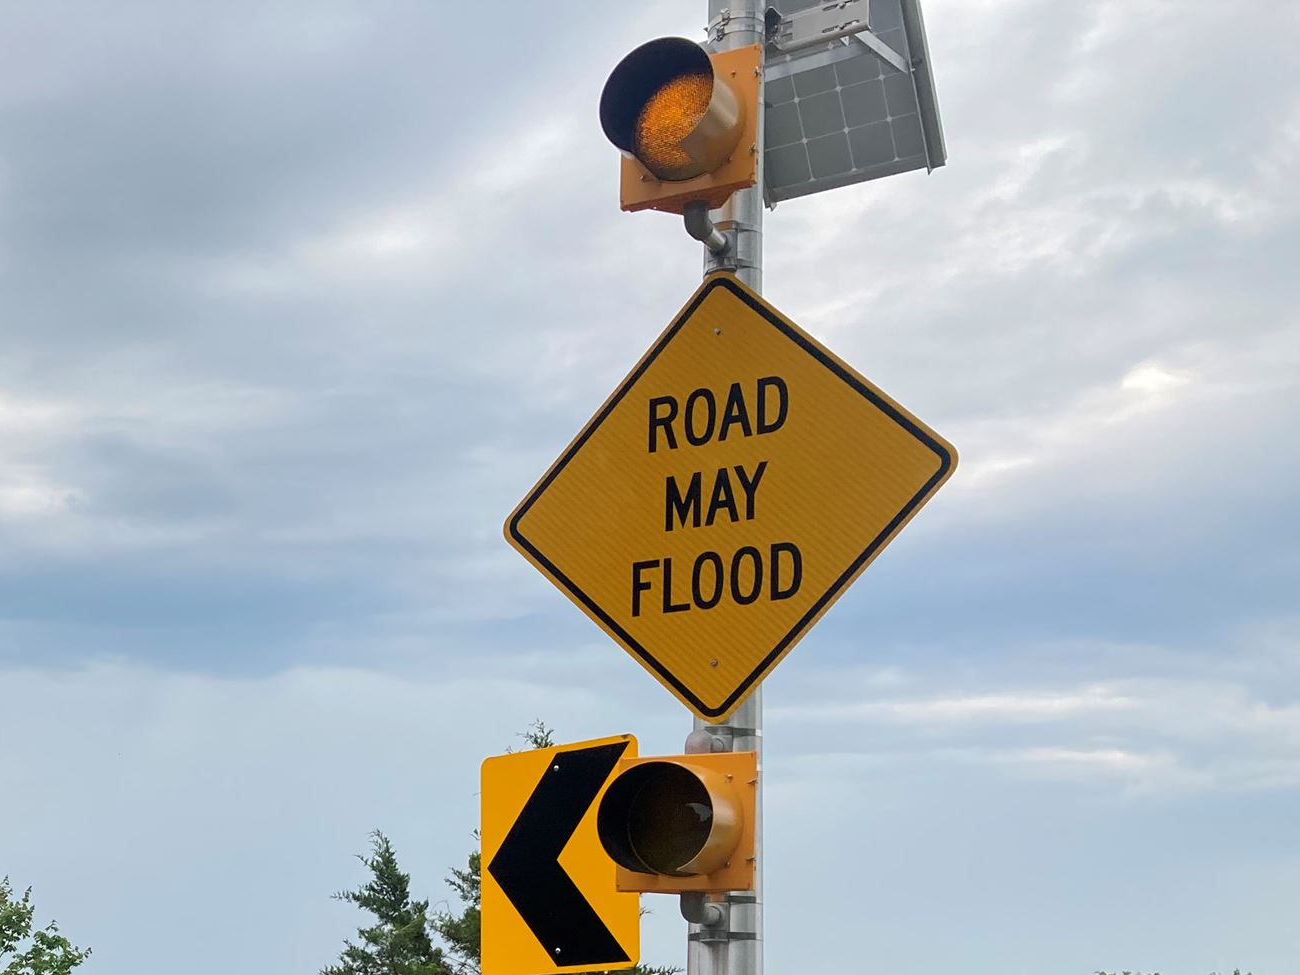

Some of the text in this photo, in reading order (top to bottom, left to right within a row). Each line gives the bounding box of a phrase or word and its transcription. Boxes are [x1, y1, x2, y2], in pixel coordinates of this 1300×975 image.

[648, 376, 789, 453] ROAD
[665, 461, 768, 532] MAY
[631, 542, 803, 617] FLOOD
